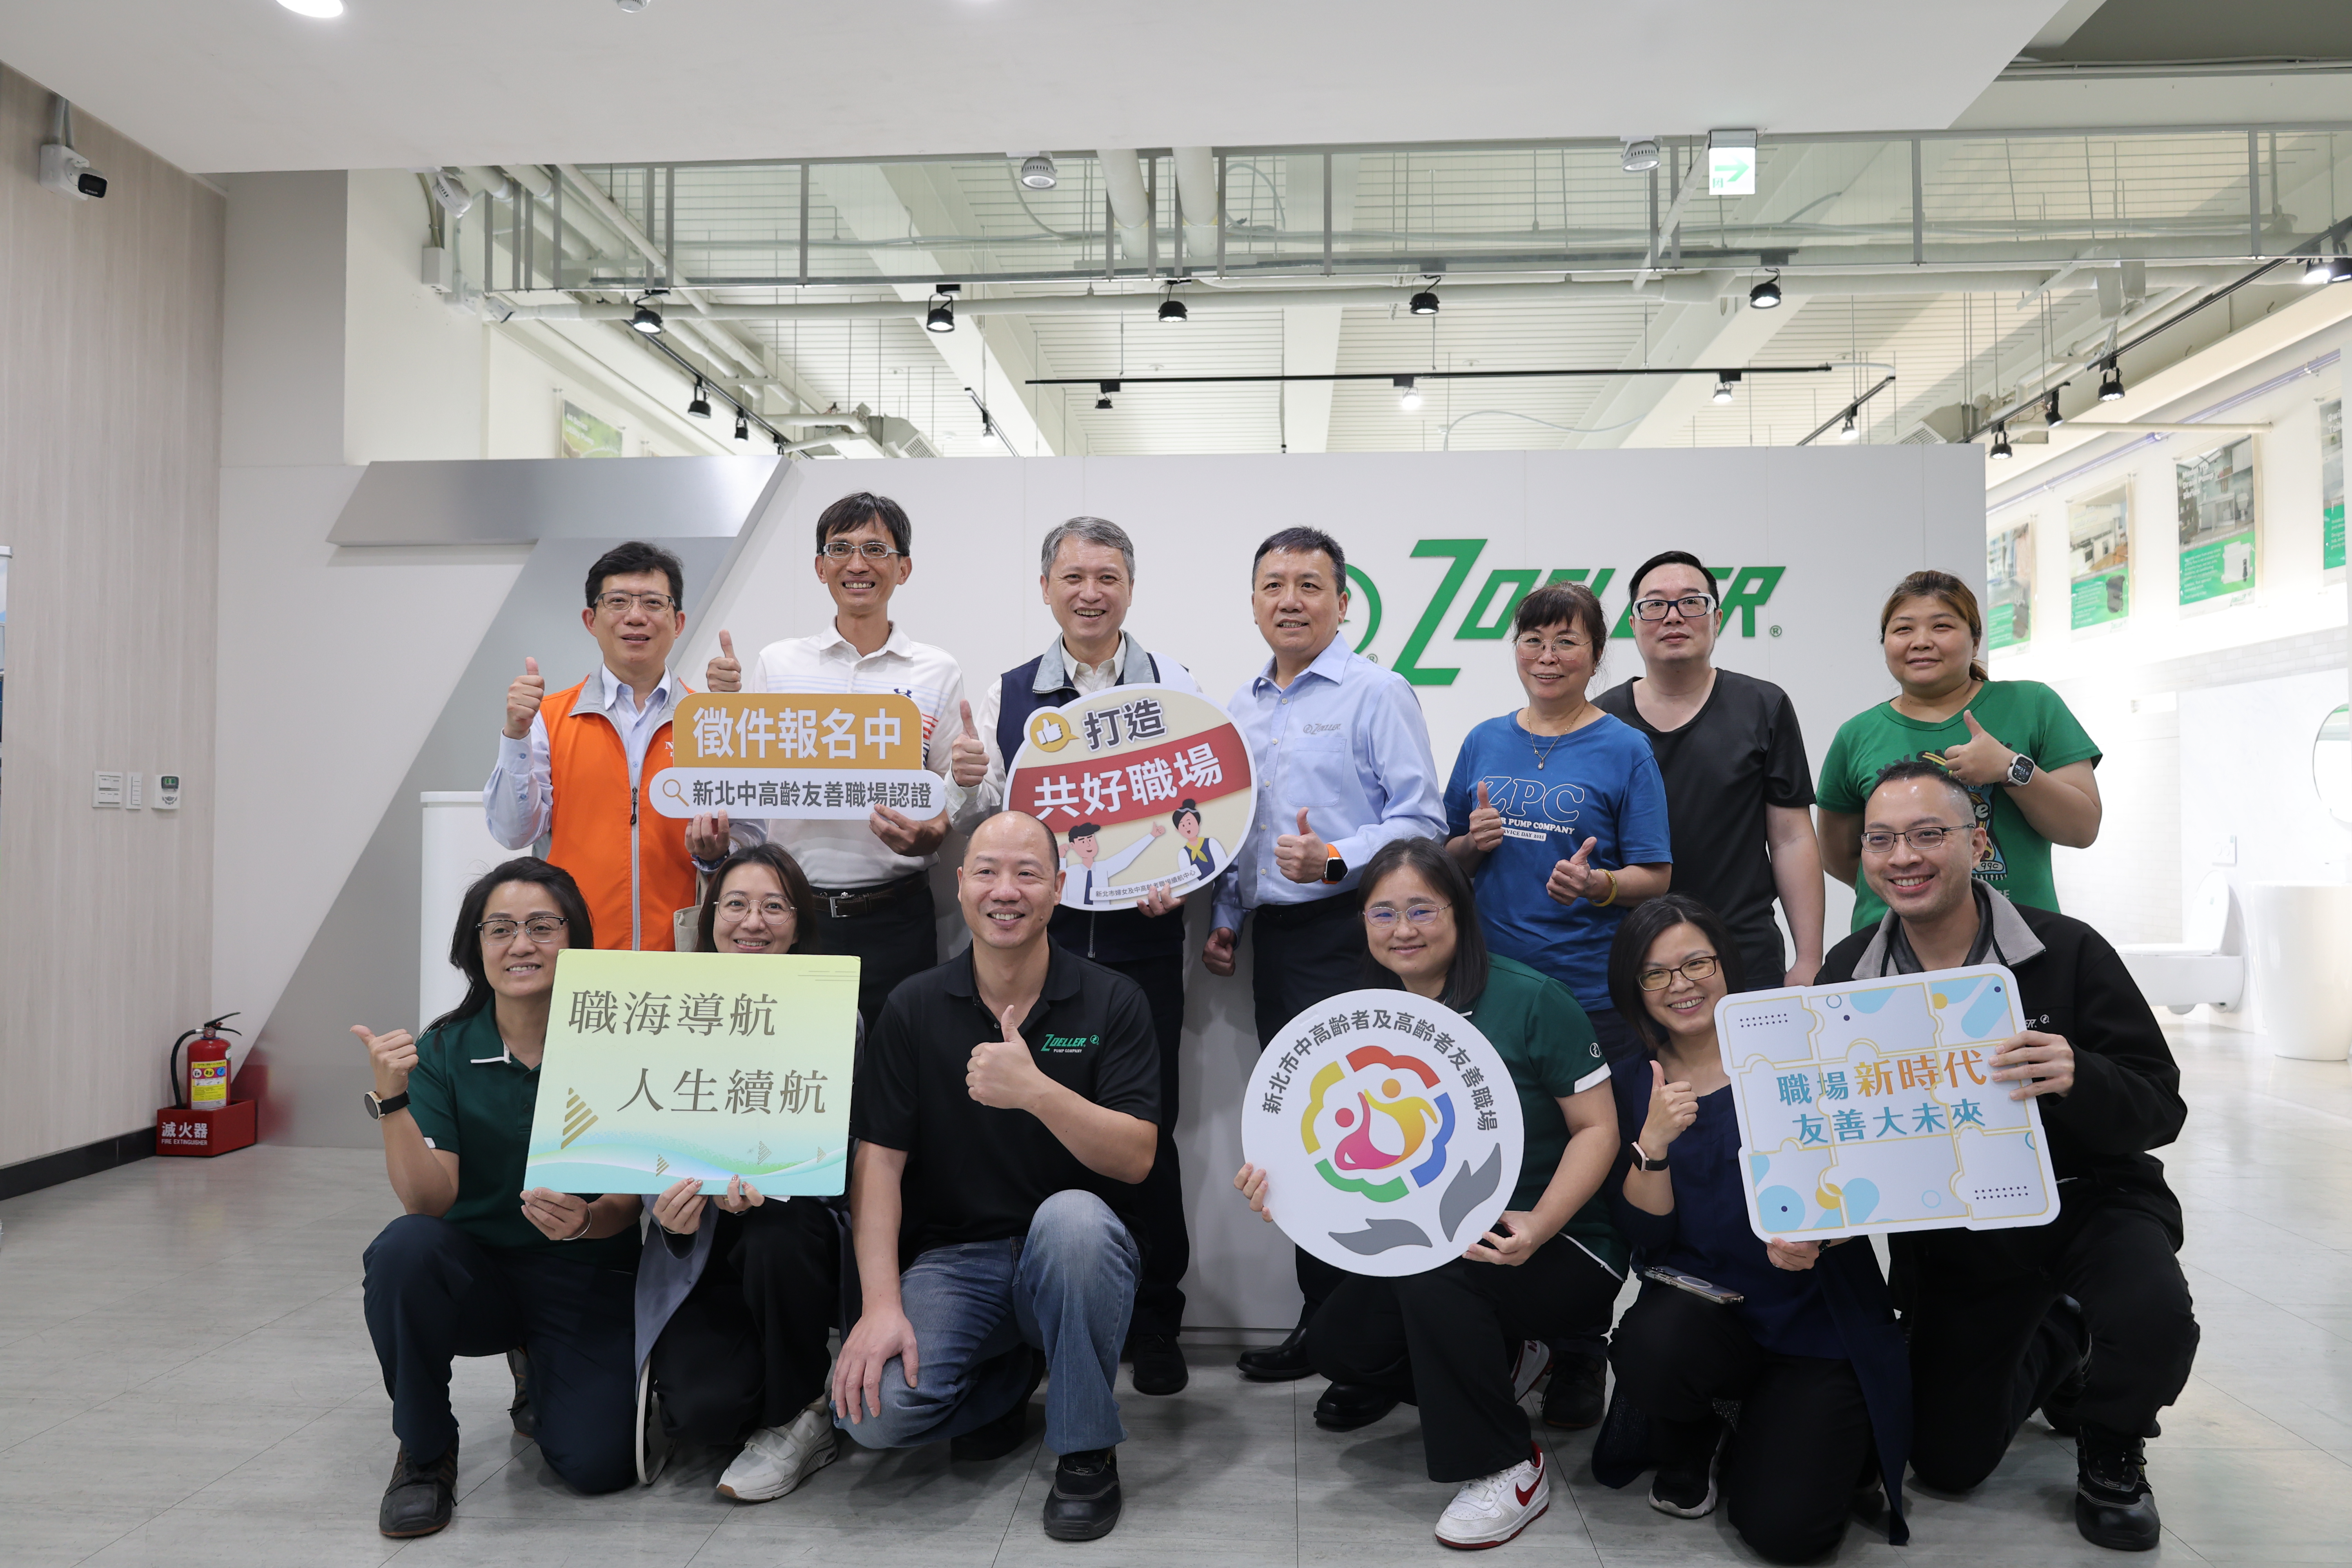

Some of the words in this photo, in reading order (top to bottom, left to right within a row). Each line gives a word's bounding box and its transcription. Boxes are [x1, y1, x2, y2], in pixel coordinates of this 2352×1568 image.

[2182, 466, 2199, 479] Model
[2182, 478, 2198, 489] Drain
[2198, 472, 2214, 483] Pump
[692, 707, 901, 759] 徵件報名中
[1085, 700, 1165, 750] 打造
[692, 780, 932, 808] 新北中高齡友善職場認證
[1033, 742, 1223, 820] 共好職場
[1475, 776, 1584, 822] ZPC
[1508, 818, 1532, 829] PUMP
[1533, 822, 1575, 835] COMPANY
[568, 990, 778, 1036] 職海導航
[1041, 1034, 1087, 1051] ZOELLER
[617, 1067, 828, 1115] 人生續航
[1262, 1009, 1498, 1131] 新北市中高齡者及高齡者友善職場
[161, 1121, 208, 1138] 滅火器
